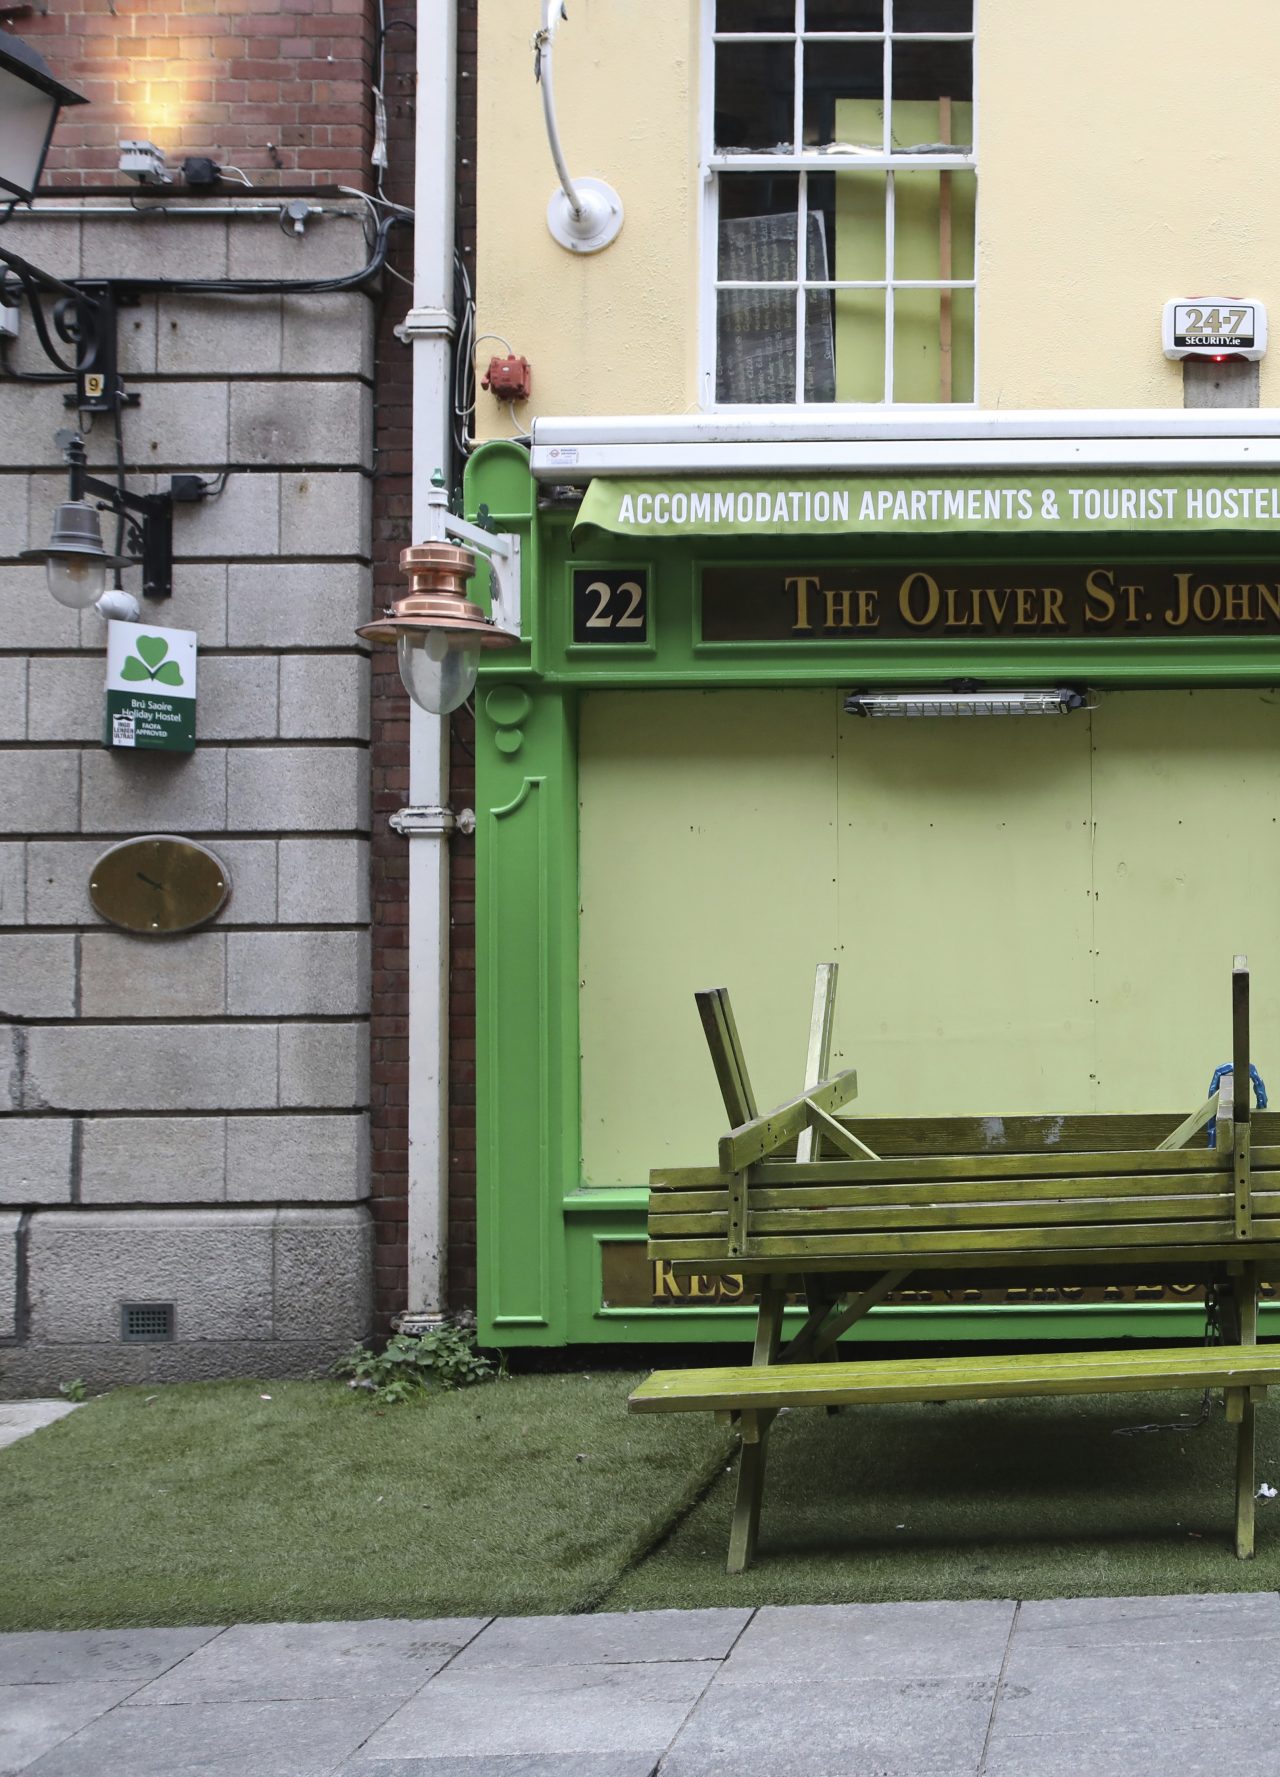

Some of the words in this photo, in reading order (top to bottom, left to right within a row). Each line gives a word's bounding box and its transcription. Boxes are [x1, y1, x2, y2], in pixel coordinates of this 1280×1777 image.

[1185, 336, 1241, 345] SECURITY.ie
[88, 377, 99, 392] 9
[618, 490, 849, 525] ACCOMMODATION
[858, 488, 1033, 521] APARTMENTS
[1041, 488, 1061, 520] &
[1068, 488, 1178, 519] TOURIST
[585, 581, 645, 628] 22
[785, 575, 880, 630] THE
[899, 572, 1067, 628] OLIVER
[148, 701, 172, 711] Saoire
[121, 708, 153, 721] Holiday
[155, 711, 182, 722] Hostel
[135, 728, 168, 738] APPROVED
